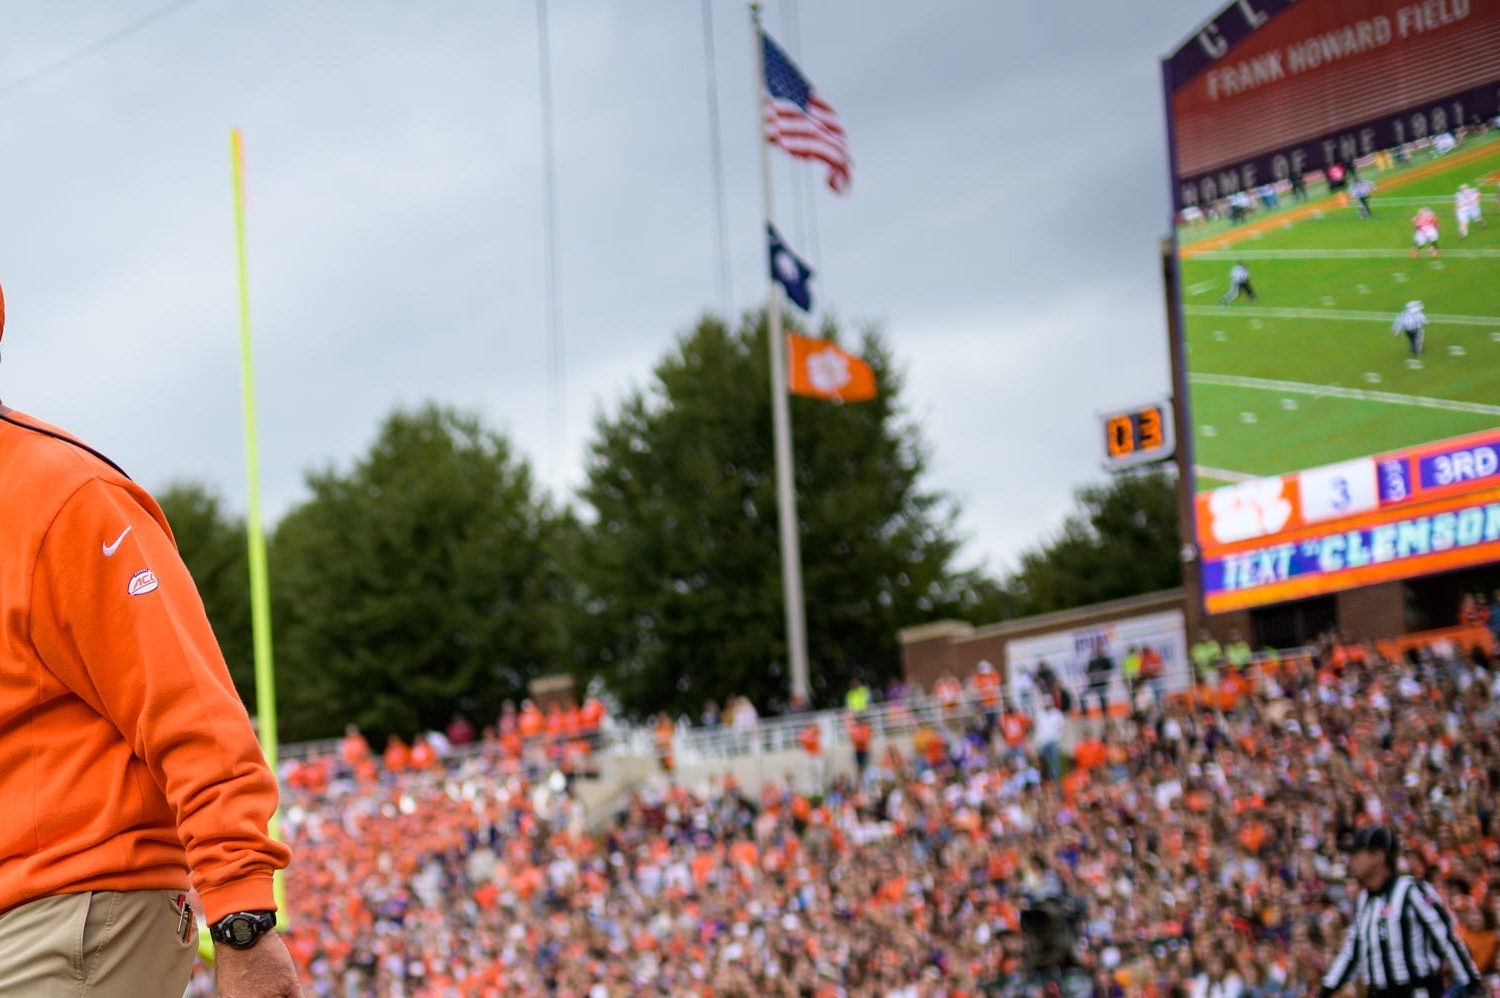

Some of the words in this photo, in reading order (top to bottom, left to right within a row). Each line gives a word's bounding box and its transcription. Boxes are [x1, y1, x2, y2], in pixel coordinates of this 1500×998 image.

[1206, 51, 1286, 101] FRANK
[1287, 15, 1392, 75] HOWARD
[1396, 0, 1471, 39] FIELD
[1182, 163, 1258, 206] HOME
[1272, 149, 1308, 183] OF
[1321, 127, 1376, 165] THE
[1387, 473, 1407, 502] 3
[1434, 446, 1499, 486] 3RD
[1329, 474, 1353, 512] 3
[1222, 541, 1297, 592] TEXT
